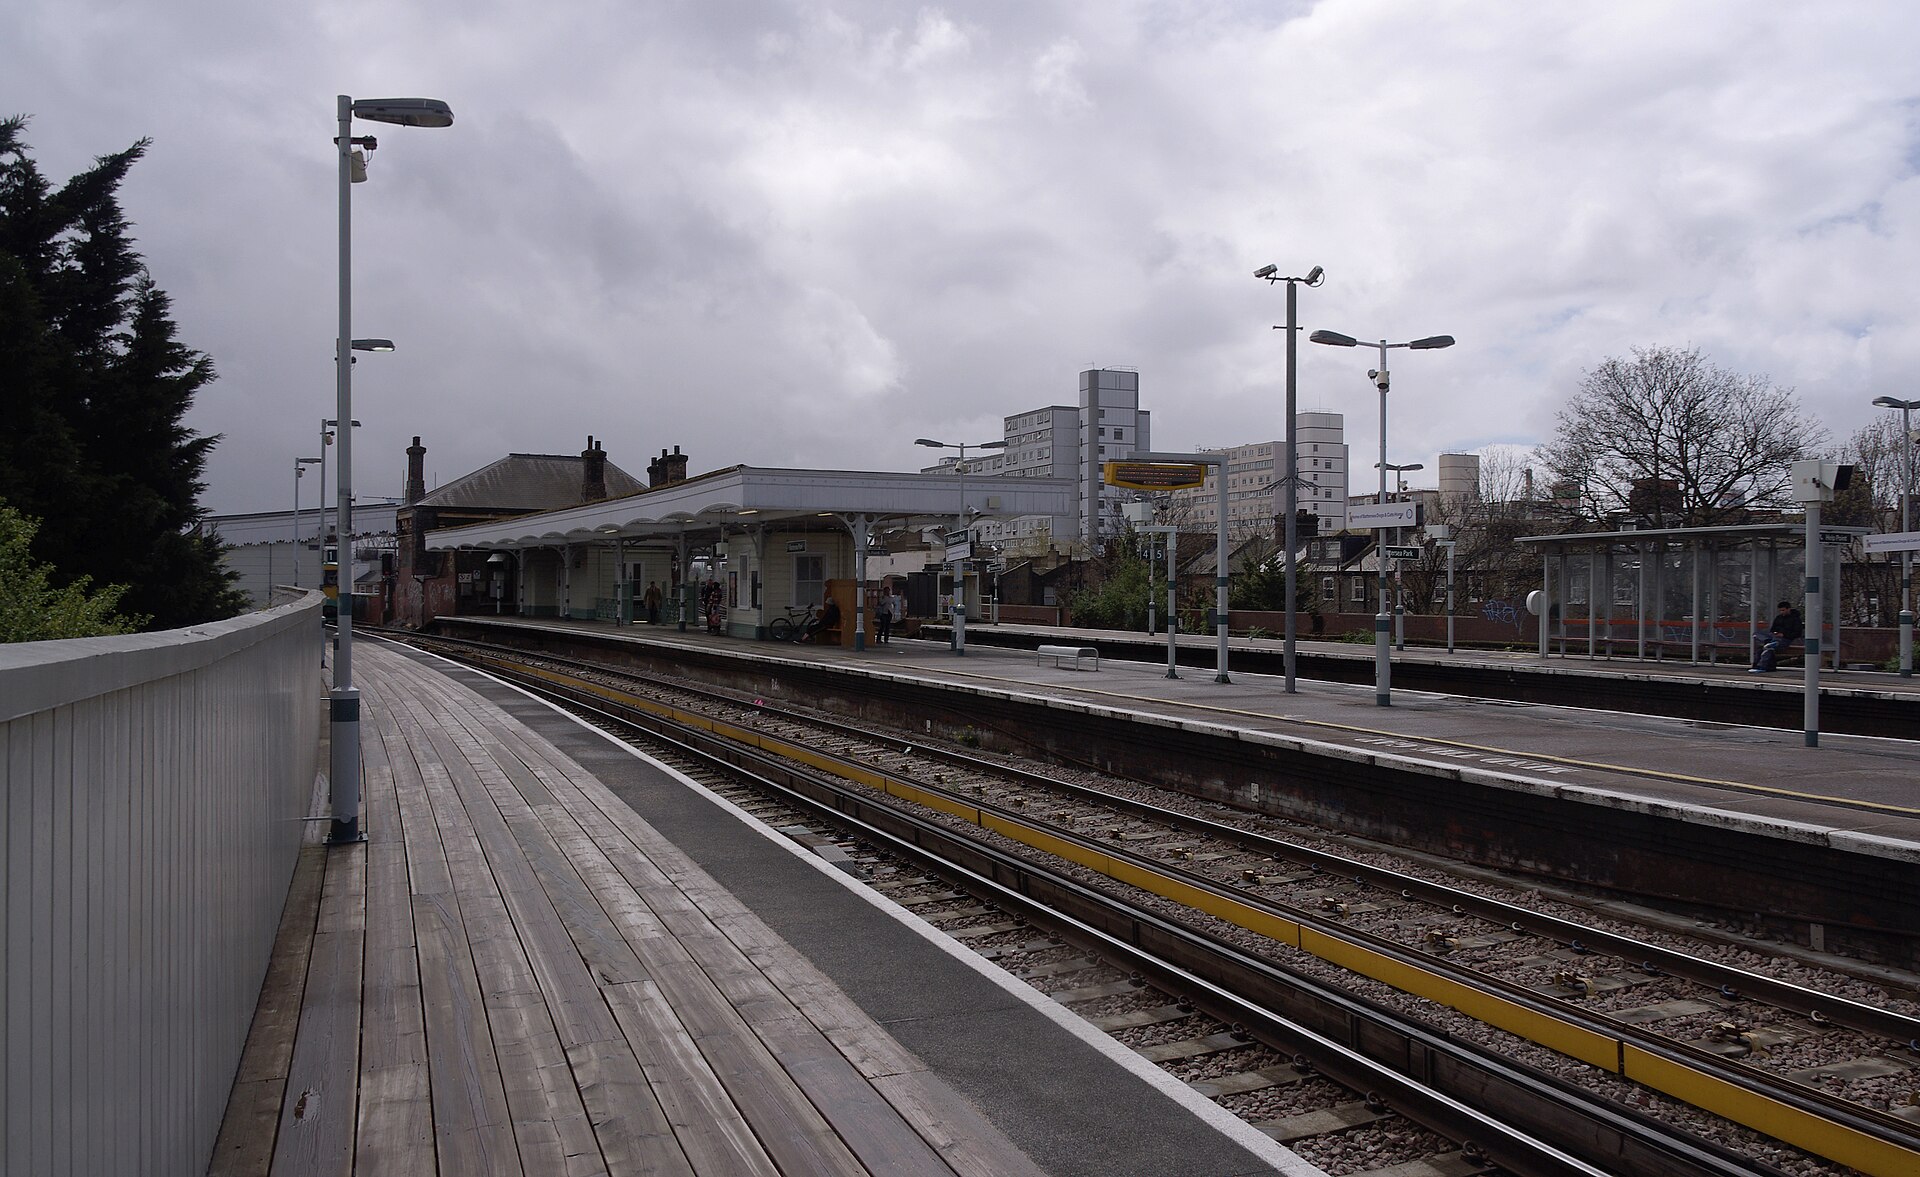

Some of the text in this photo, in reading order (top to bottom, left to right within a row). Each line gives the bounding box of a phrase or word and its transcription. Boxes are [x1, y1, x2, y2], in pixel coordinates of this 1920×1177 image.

[1143, 549, 1148, 559] 4
[1157, 549, 1162, 559] 5
[1402, 549, 1413, 557] Park
